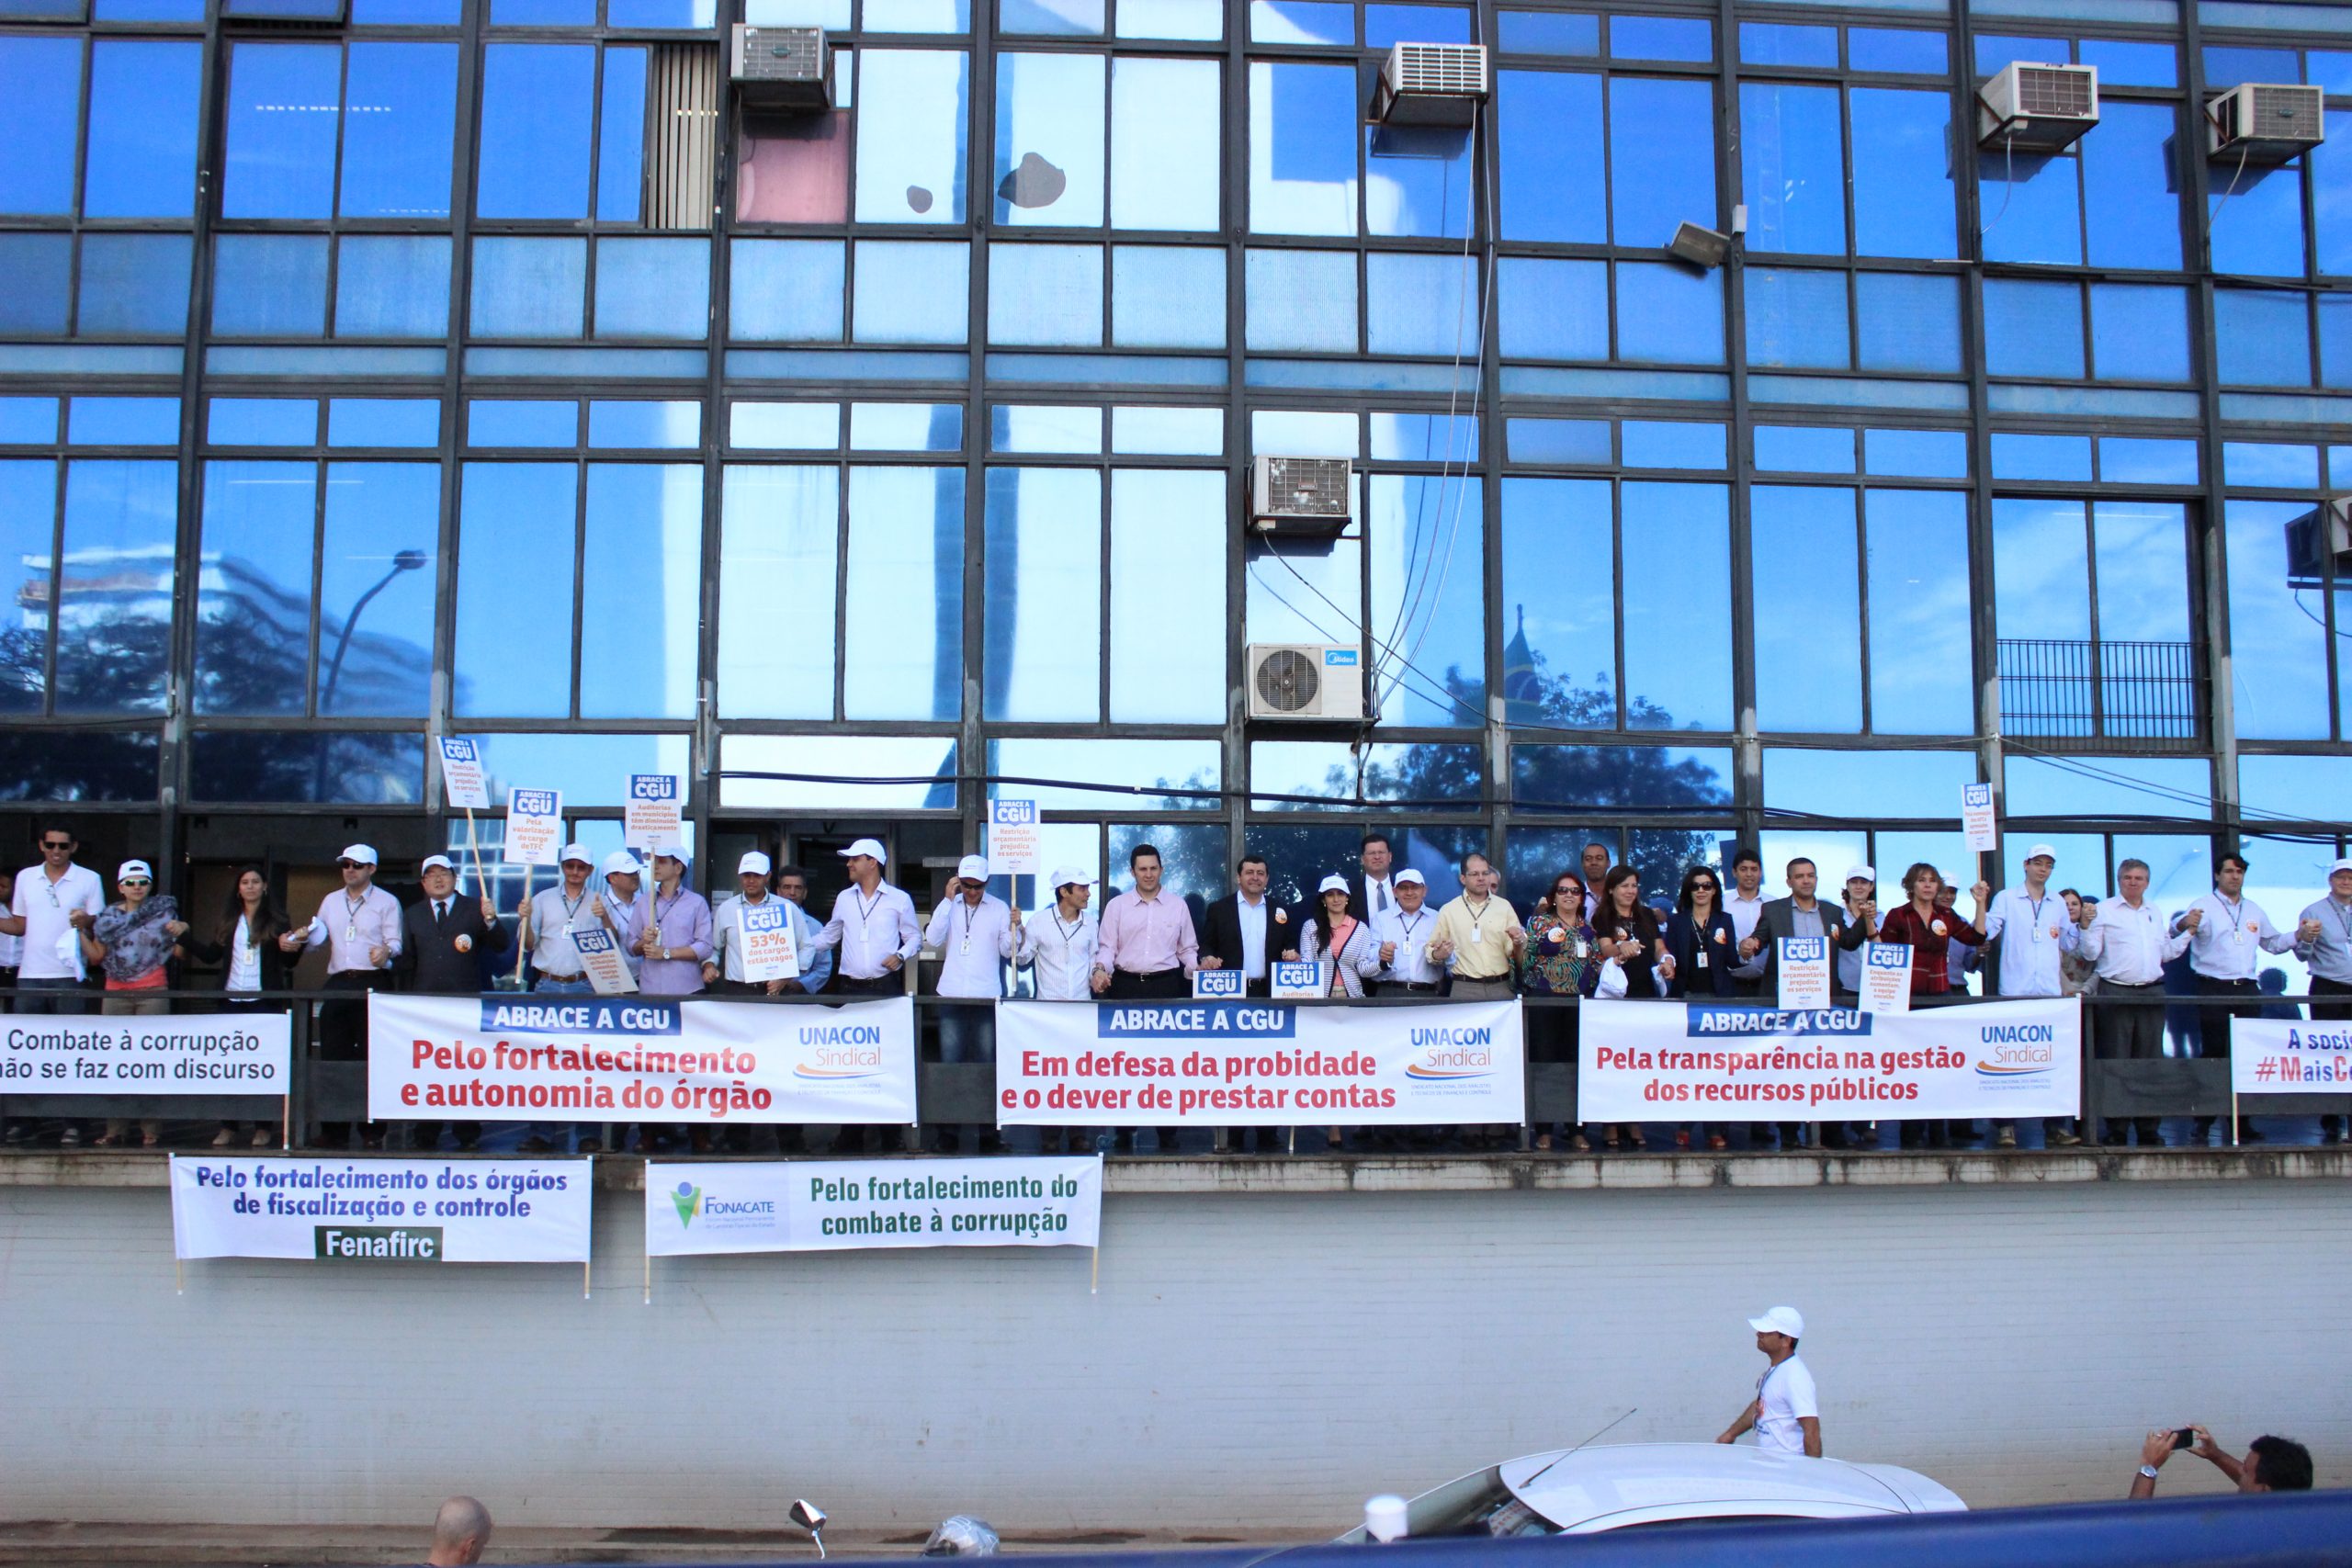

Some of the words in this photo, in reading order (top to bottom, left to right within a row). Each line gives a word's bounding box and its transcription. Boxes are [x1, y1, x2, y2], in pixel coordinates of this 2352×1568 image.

[445, 745, 473, 760] CGU
[519, 791, 546, 799] ABRACE
[635, 783, 672, 797] CGU
[1966, 790, 1987, 805] CGU
[516, 797, 552, 814] CGU
[997, 807, 1031, 822] CGU
[513, 827, 555, 835] valorização
[747, 912, 783, 931] CGU
[748, 908, 775, 916] ABRACE
[578, 936, 609, 951] CGU
[750, 932, 786, 948] 53%
[747, 956, 769, 965] estão
[769, 953, 794, 963] vagos
[763, 946, 790, 954] cargos
[1786, 944, 1820, 959] CGU
[1871, 950, 1905, 966] CGU
[1202, 978, 1237, 992] CGU
[1280, 970, 1315, 985] CGU
[1789, 978, 1819, 987] prejudica
[492, 1006, 591, 1030] ABRACE
[595, 1008, 616, 1029] A
[620, 1007, 671, 1031] CGU
[1109, 1009, 1205, 1031] ABRACE
[1211, 1009, 1230, 1031] A
[1235, 1009, 1284, 1032] CGU
[1699, 1012, 1788, 1032] ABRACE
[1792, 1010, 1810, 1031] A
[1815, 1010, 1861, 1031] CGU
[8, 1028, 112, 1051] Combate
[120, 1029, 132, 1051] à
[141, 1030, 260, 1056] corrupção
[799, 1026, 880, 1045] UNACON
[1410, 1027, 1490, 1046] UNACON
[1981, 1025, 2052, 1043] UNACON
[2287, 1028, 2301, 1050] A
[2307, 1029, 2352, 1050] soci
[411, 1039, 488, 1071] Pelo
[492, 1043, 757, 1076] fortalecimento
[816, 1046, 881, 1066] Sindical
[1427, 1047, 1491, 1066] Sindical
[1596, 1046, 1653, 1071] Pela
[1657, 1044, 1839, 1076] transparência
[1843, 1051, 1876, 1070] na
[1880, 1045, 1966, 1076] gestão
[1995, 1044, 2052, 1064] Sindical
[40, 1062, 68, 1078] se
[75, 1058, 108, 1078] faz
[117, 1062, 165, 1078] com
[174, 1058, 276, 1079] discurso
[1022, 1051, 1069, 1077] Em
[1075, 1049, 1176, 1077] defesa
[1181, 1049, 1219, 1077] da
[1225, 1048, 1376, 1089] probidade
[2255, 1055, 2352, 1082] #MaisC
[401, 1081, 419, 1106] e
[425, 1077, 616, 1111] autonomia
[621, 1078, 665, 1110] do
[671, 1077, 773, 1119] órgão
[1001, 1089, 1018, 1110] e
[1023, 1089, 1042, 1110] o
[1046, 1082, 1133, 1111] dever
[1136, 1083, 1172, 1111] de
[1178, 1086, 1290, 1116] prestar
[1293, 1085, 1396, 1110] contas
[1643, 1078, 1690, 1102] dos
[1694, 1081, 1805, 1102] recursos
[1809, 1077, 1919, 1107] públicos
[197, 1165, 248, 1189] Pelo
[254, 1165, 429, 1190] fortalecimento
[435, 1167, 479, 1190] dos
[485, 1168, 568, 1196] órgãos
[810, 1177, 860, 1201] Pelo
[868, 1174, 1044, 1201] fortalecimento
[1051, 1173, 1079, 1199] do
[232, 1192, 261, 1214] de
[267, 1192, 405, 1223] fiscalização
[413, 1200, 427, 1216] e
[435, 1195, 531, 1218] controle
[820, 1210, 922, 1236] combate
[930, 1207, 944, 1234] à
[951, 1205, 1069, 1238] corrupção
[325, 1230, 435, 1258] Fenafirc
